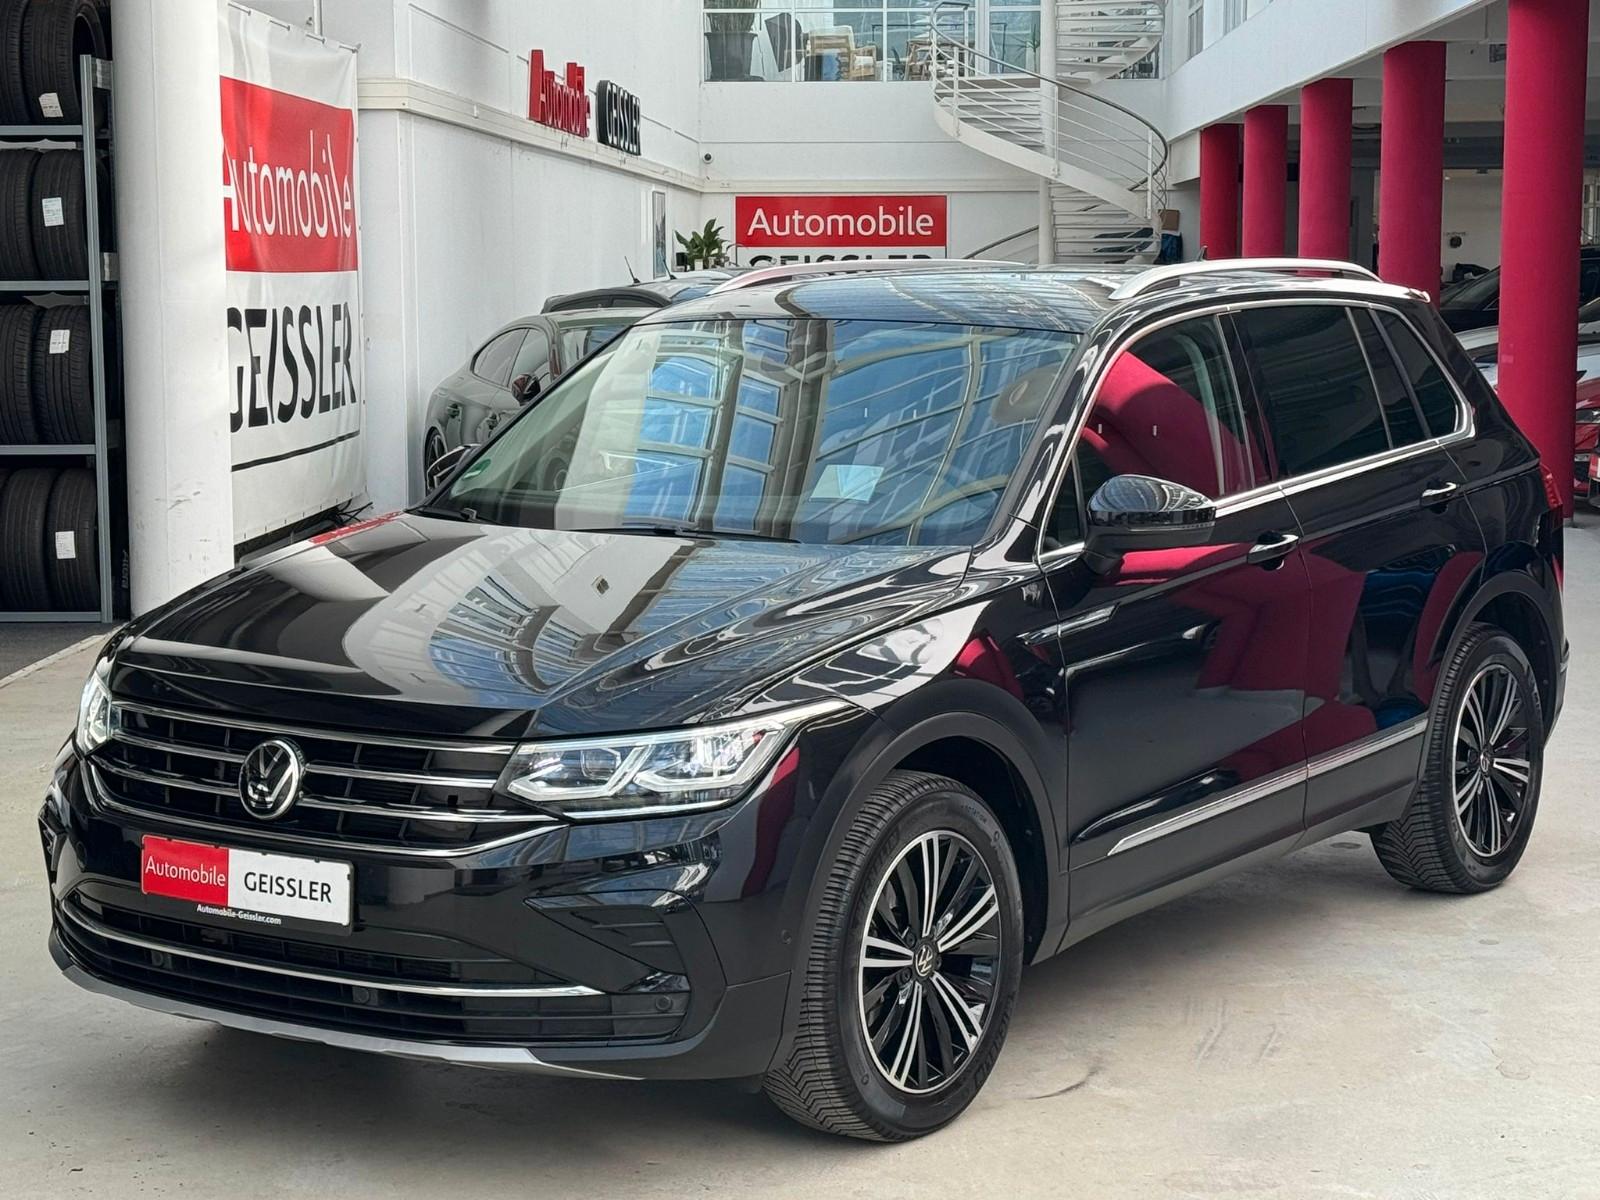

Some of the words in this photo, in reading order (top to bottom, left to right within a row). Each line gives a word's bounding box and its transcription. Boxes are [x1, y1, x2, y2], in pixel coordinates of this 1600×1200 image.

[529, 49, 590, 138] Automobile
[595, 80, 641, 155] GEISSLER
[747, 205, 934, 237] Automobile
[145, 856, 226, 887] Automobile
[244, 871, 332, 903] GEISSLER
[197, 904, 281, 925] Automobile-Geissler.com
